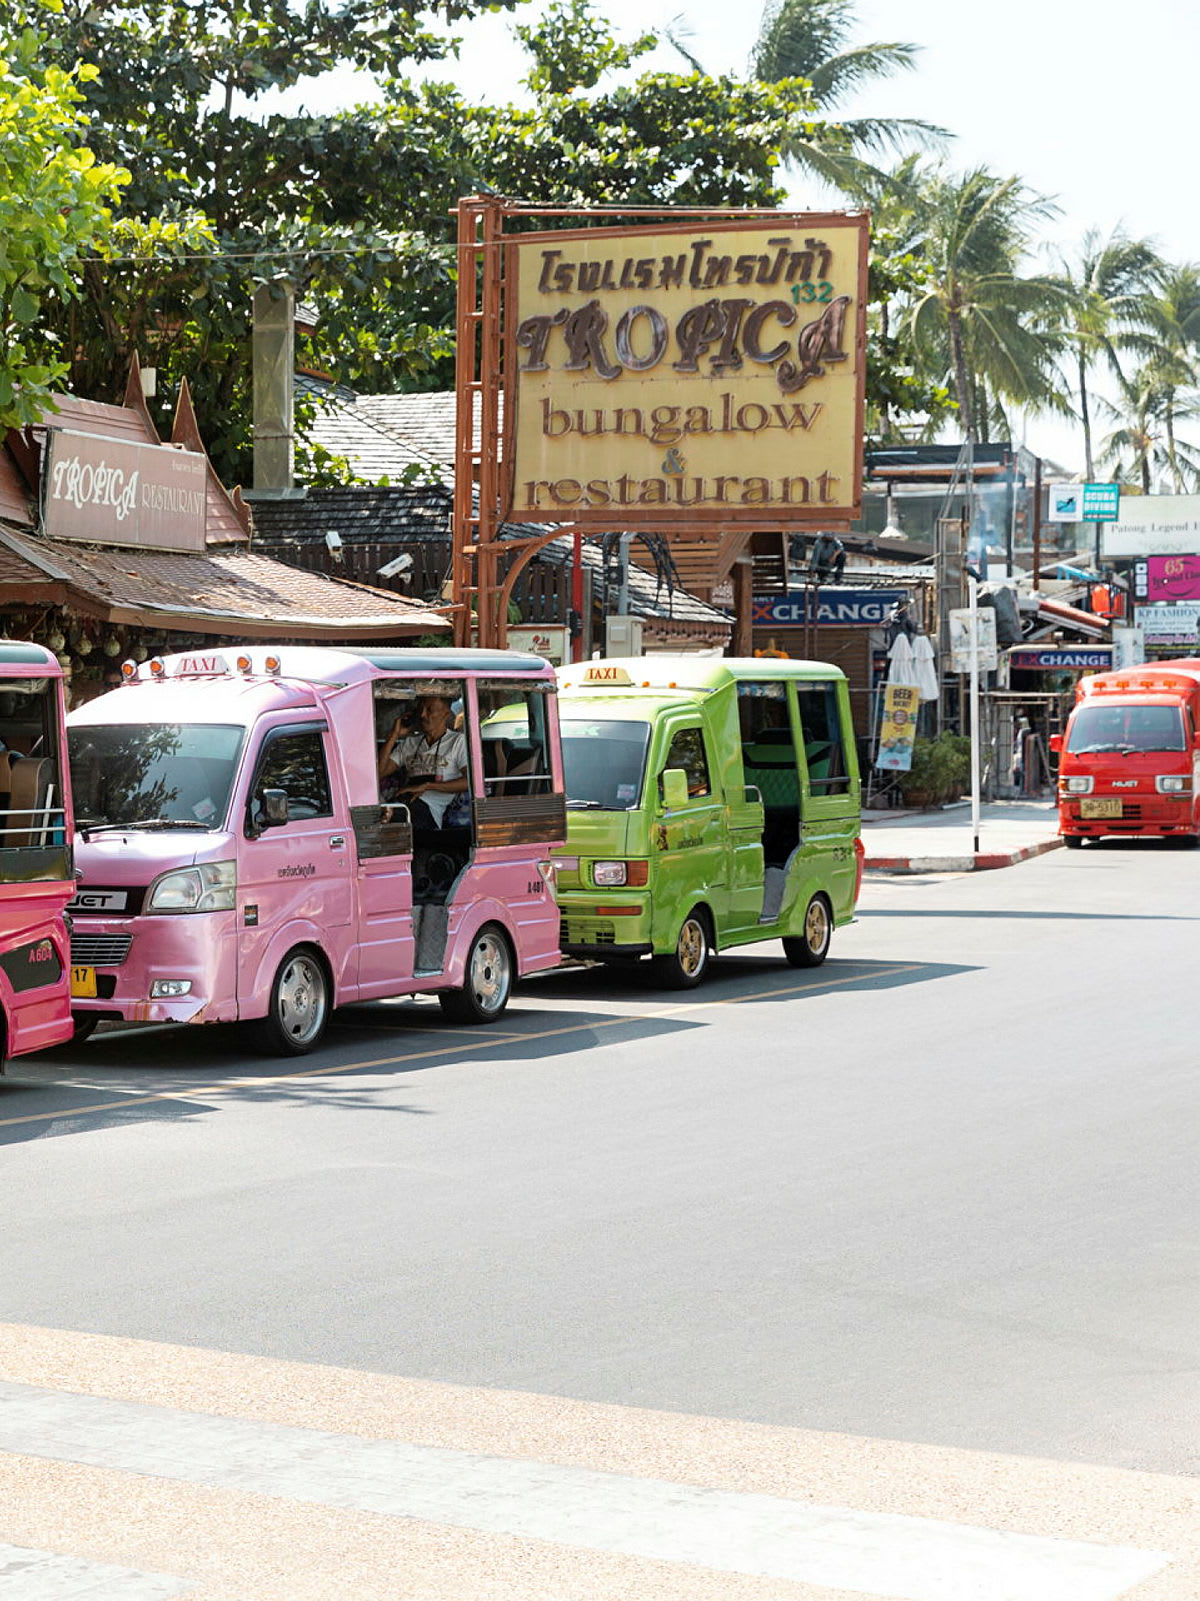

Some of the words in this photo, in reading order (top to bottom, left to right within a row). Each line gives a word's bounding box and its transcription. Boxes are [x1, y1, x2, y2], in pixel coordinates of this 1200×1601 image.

[791, 281, 834, 305] 132
[516, 294, 852, 394] TROPICA
[540, 392, 825, 445] bungalow
[661, 447, 687, 475] &
[52, 456, 140, 521] TROPICA
[141, 482, 205, 517] RESTAURANT
[522, 470, 839, 508] restaurant
[1084, 491, 1115, 501] SCUBA
[1084, 501, 1116, 511] DIVING
[1151, 521, 1188, 533] Legend
[752, 602, 897, 621] XCHANGE
[1155, 608, 1198, 617] FASHION
[181, 657, 216, 671] TAXI
[1018, 654, 1109, 666] EXCHANGE
[588, 667, 617, 680] TAXI
[66, 895, 113, 907] JET
[75, 968, 88, 982] 17
